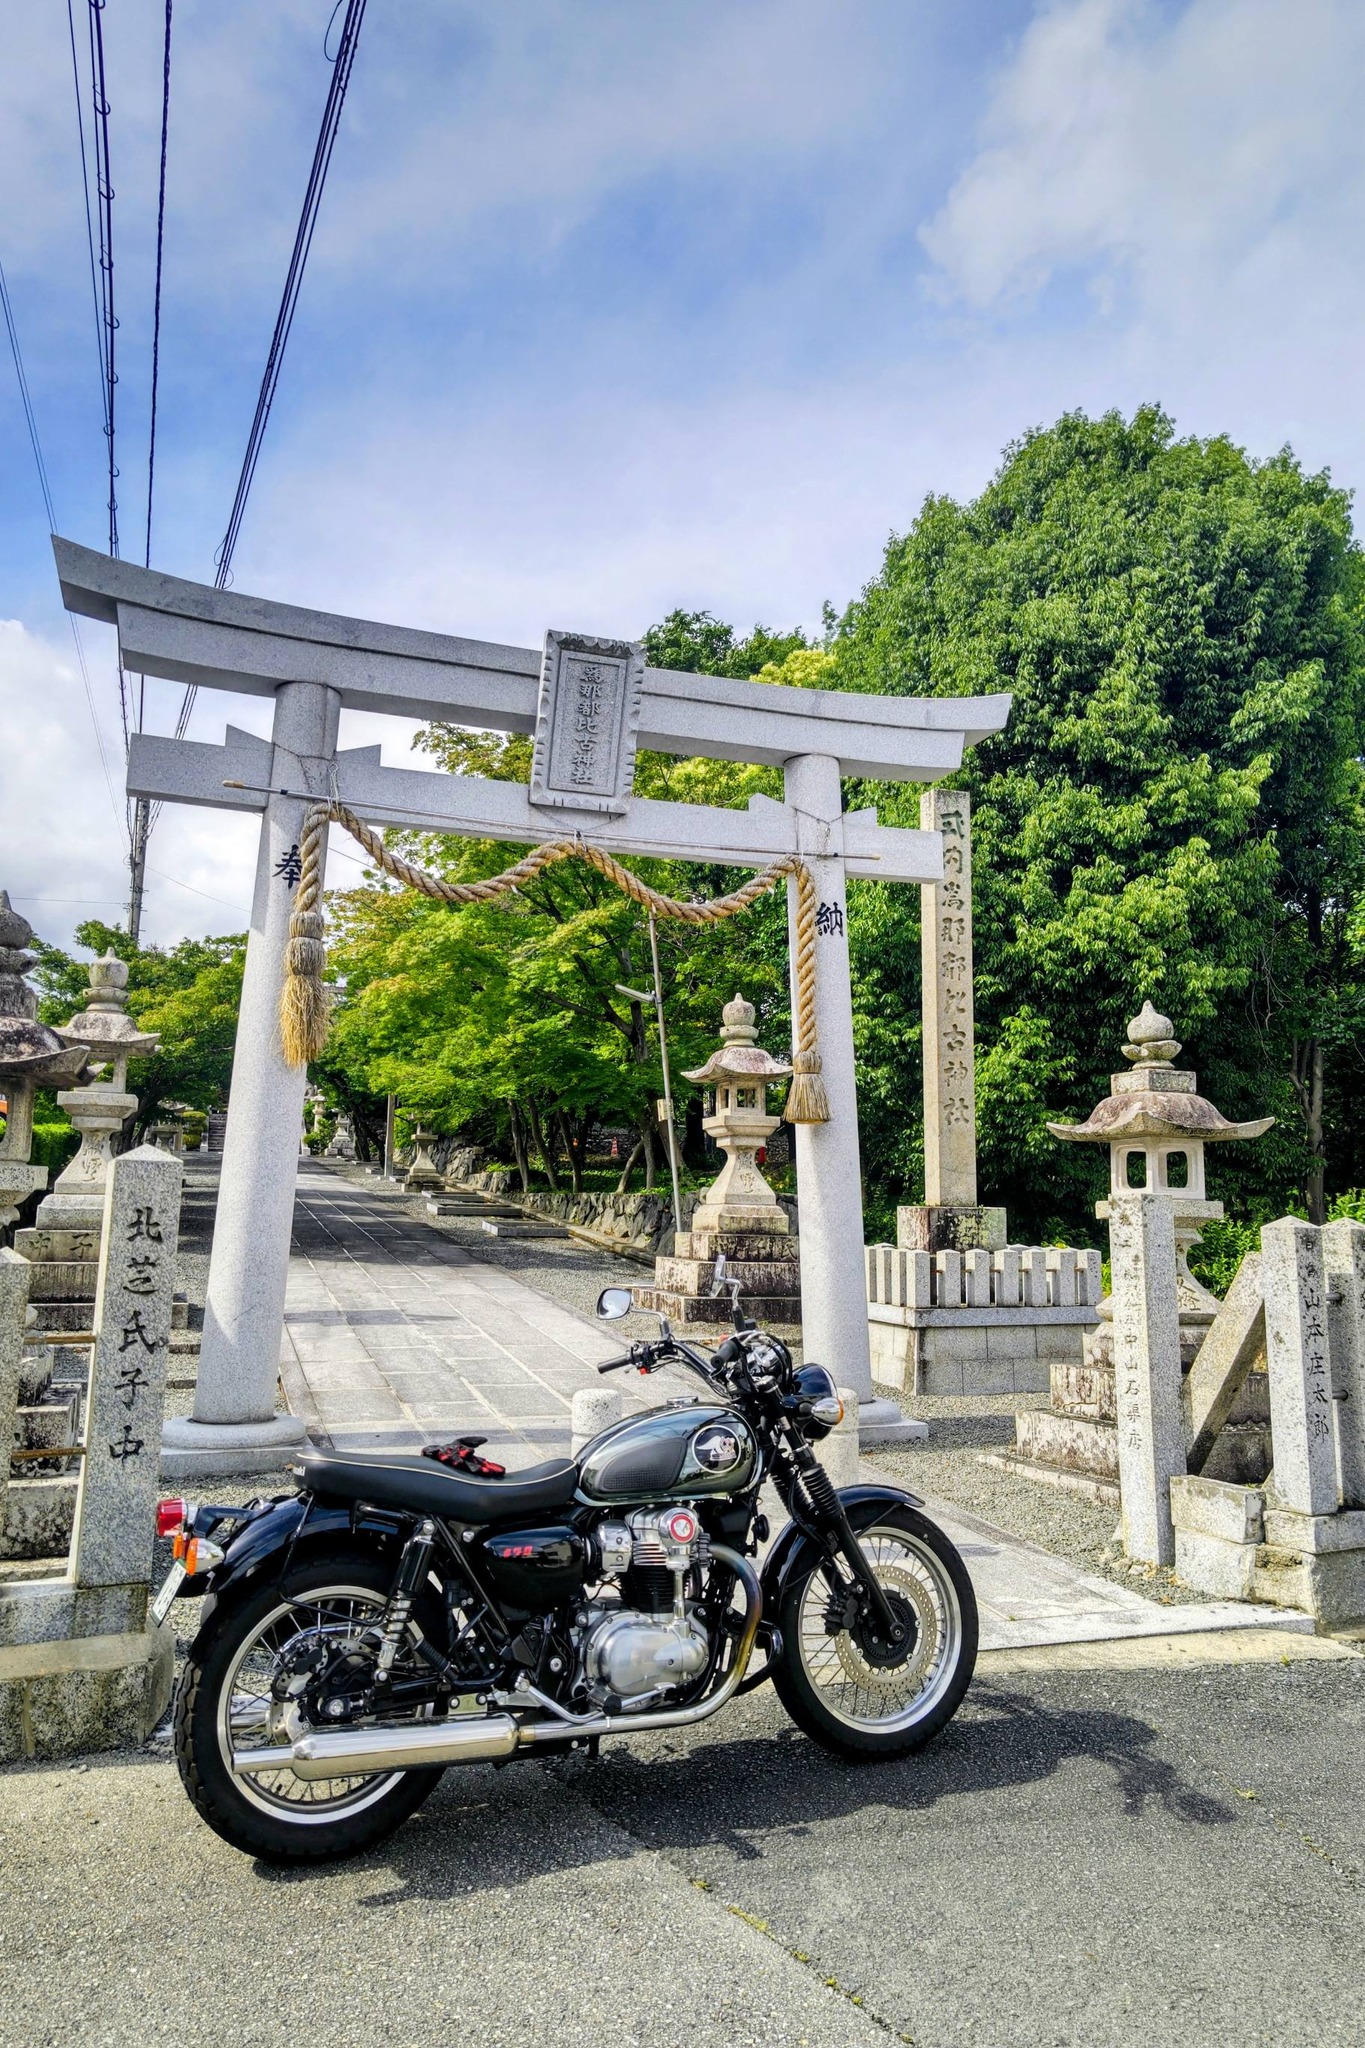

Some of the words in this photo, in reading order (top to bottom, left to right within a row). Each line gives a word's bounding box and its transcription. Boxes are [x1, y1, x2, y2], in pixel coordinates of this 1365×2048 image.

[272, 844, 302, 890] 奉
[815, 902, 843, 937] 納
[109, 1206, 164, 1464] 北芝氏子中
